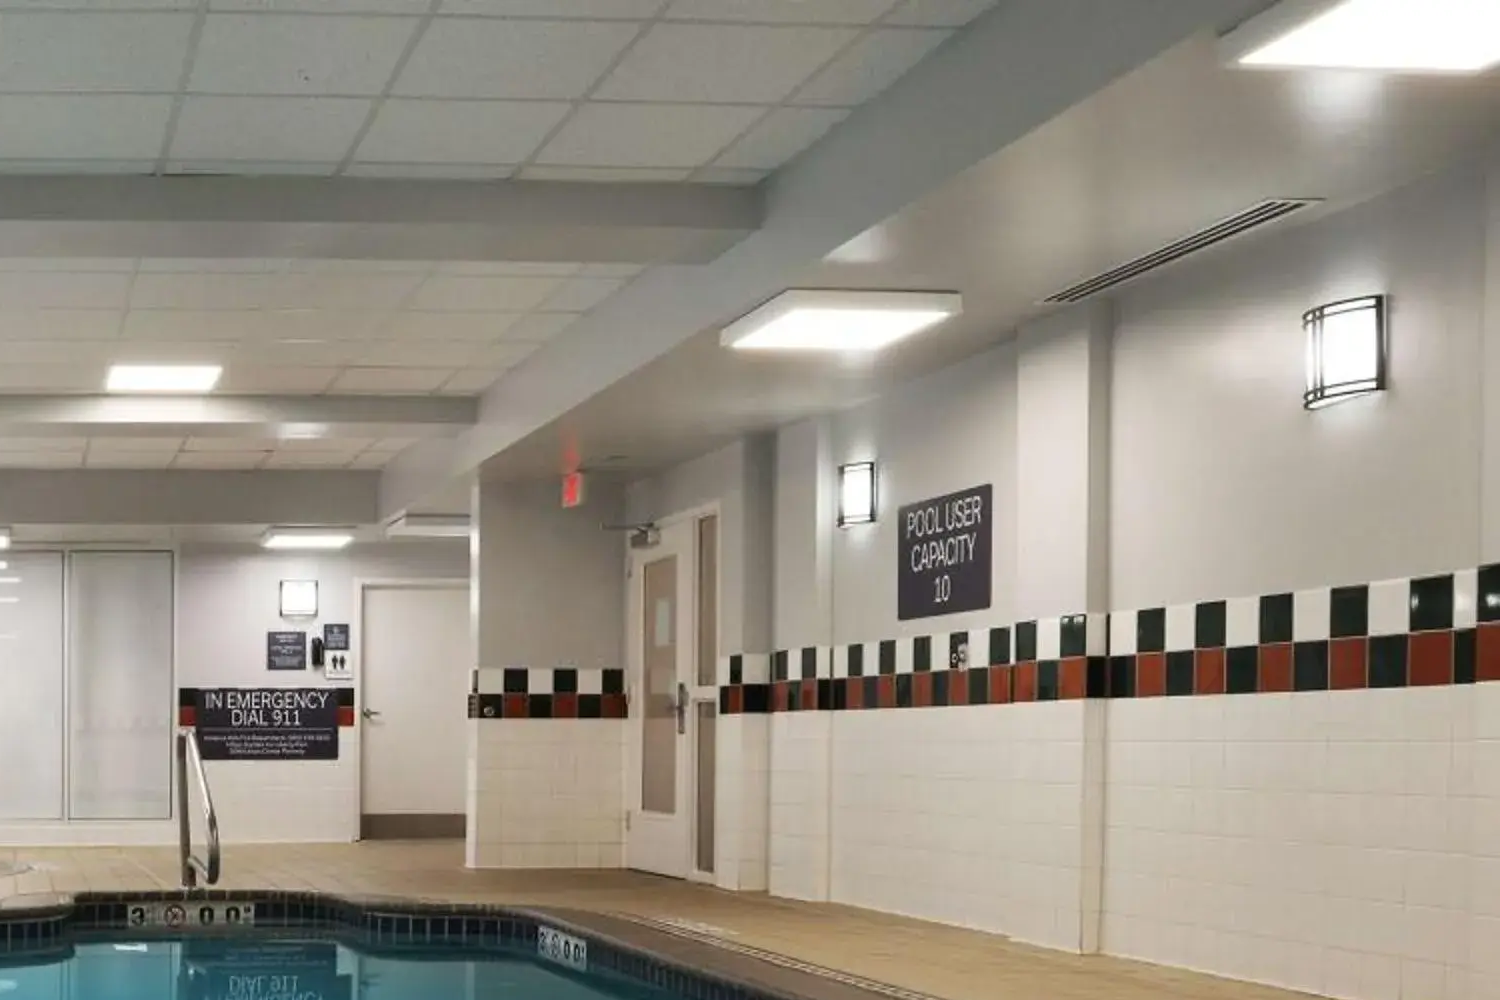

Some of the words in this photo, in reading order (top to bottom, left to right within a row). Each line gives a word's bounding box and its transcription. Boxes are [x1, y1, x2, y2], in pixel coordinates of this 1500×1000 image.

[906, 506, 943, 539] POOL
[945, 495, 982, 531] USER
[911, 532, 976, 573] CAPACITY
[934, 575, 952, 603] 10
[205, 691, 223, 709] IN
[227, 692, 328, 708] EMERGENCY
[231, 709, 268, 726] DIAL
[273, 709, 301, 726] 911
